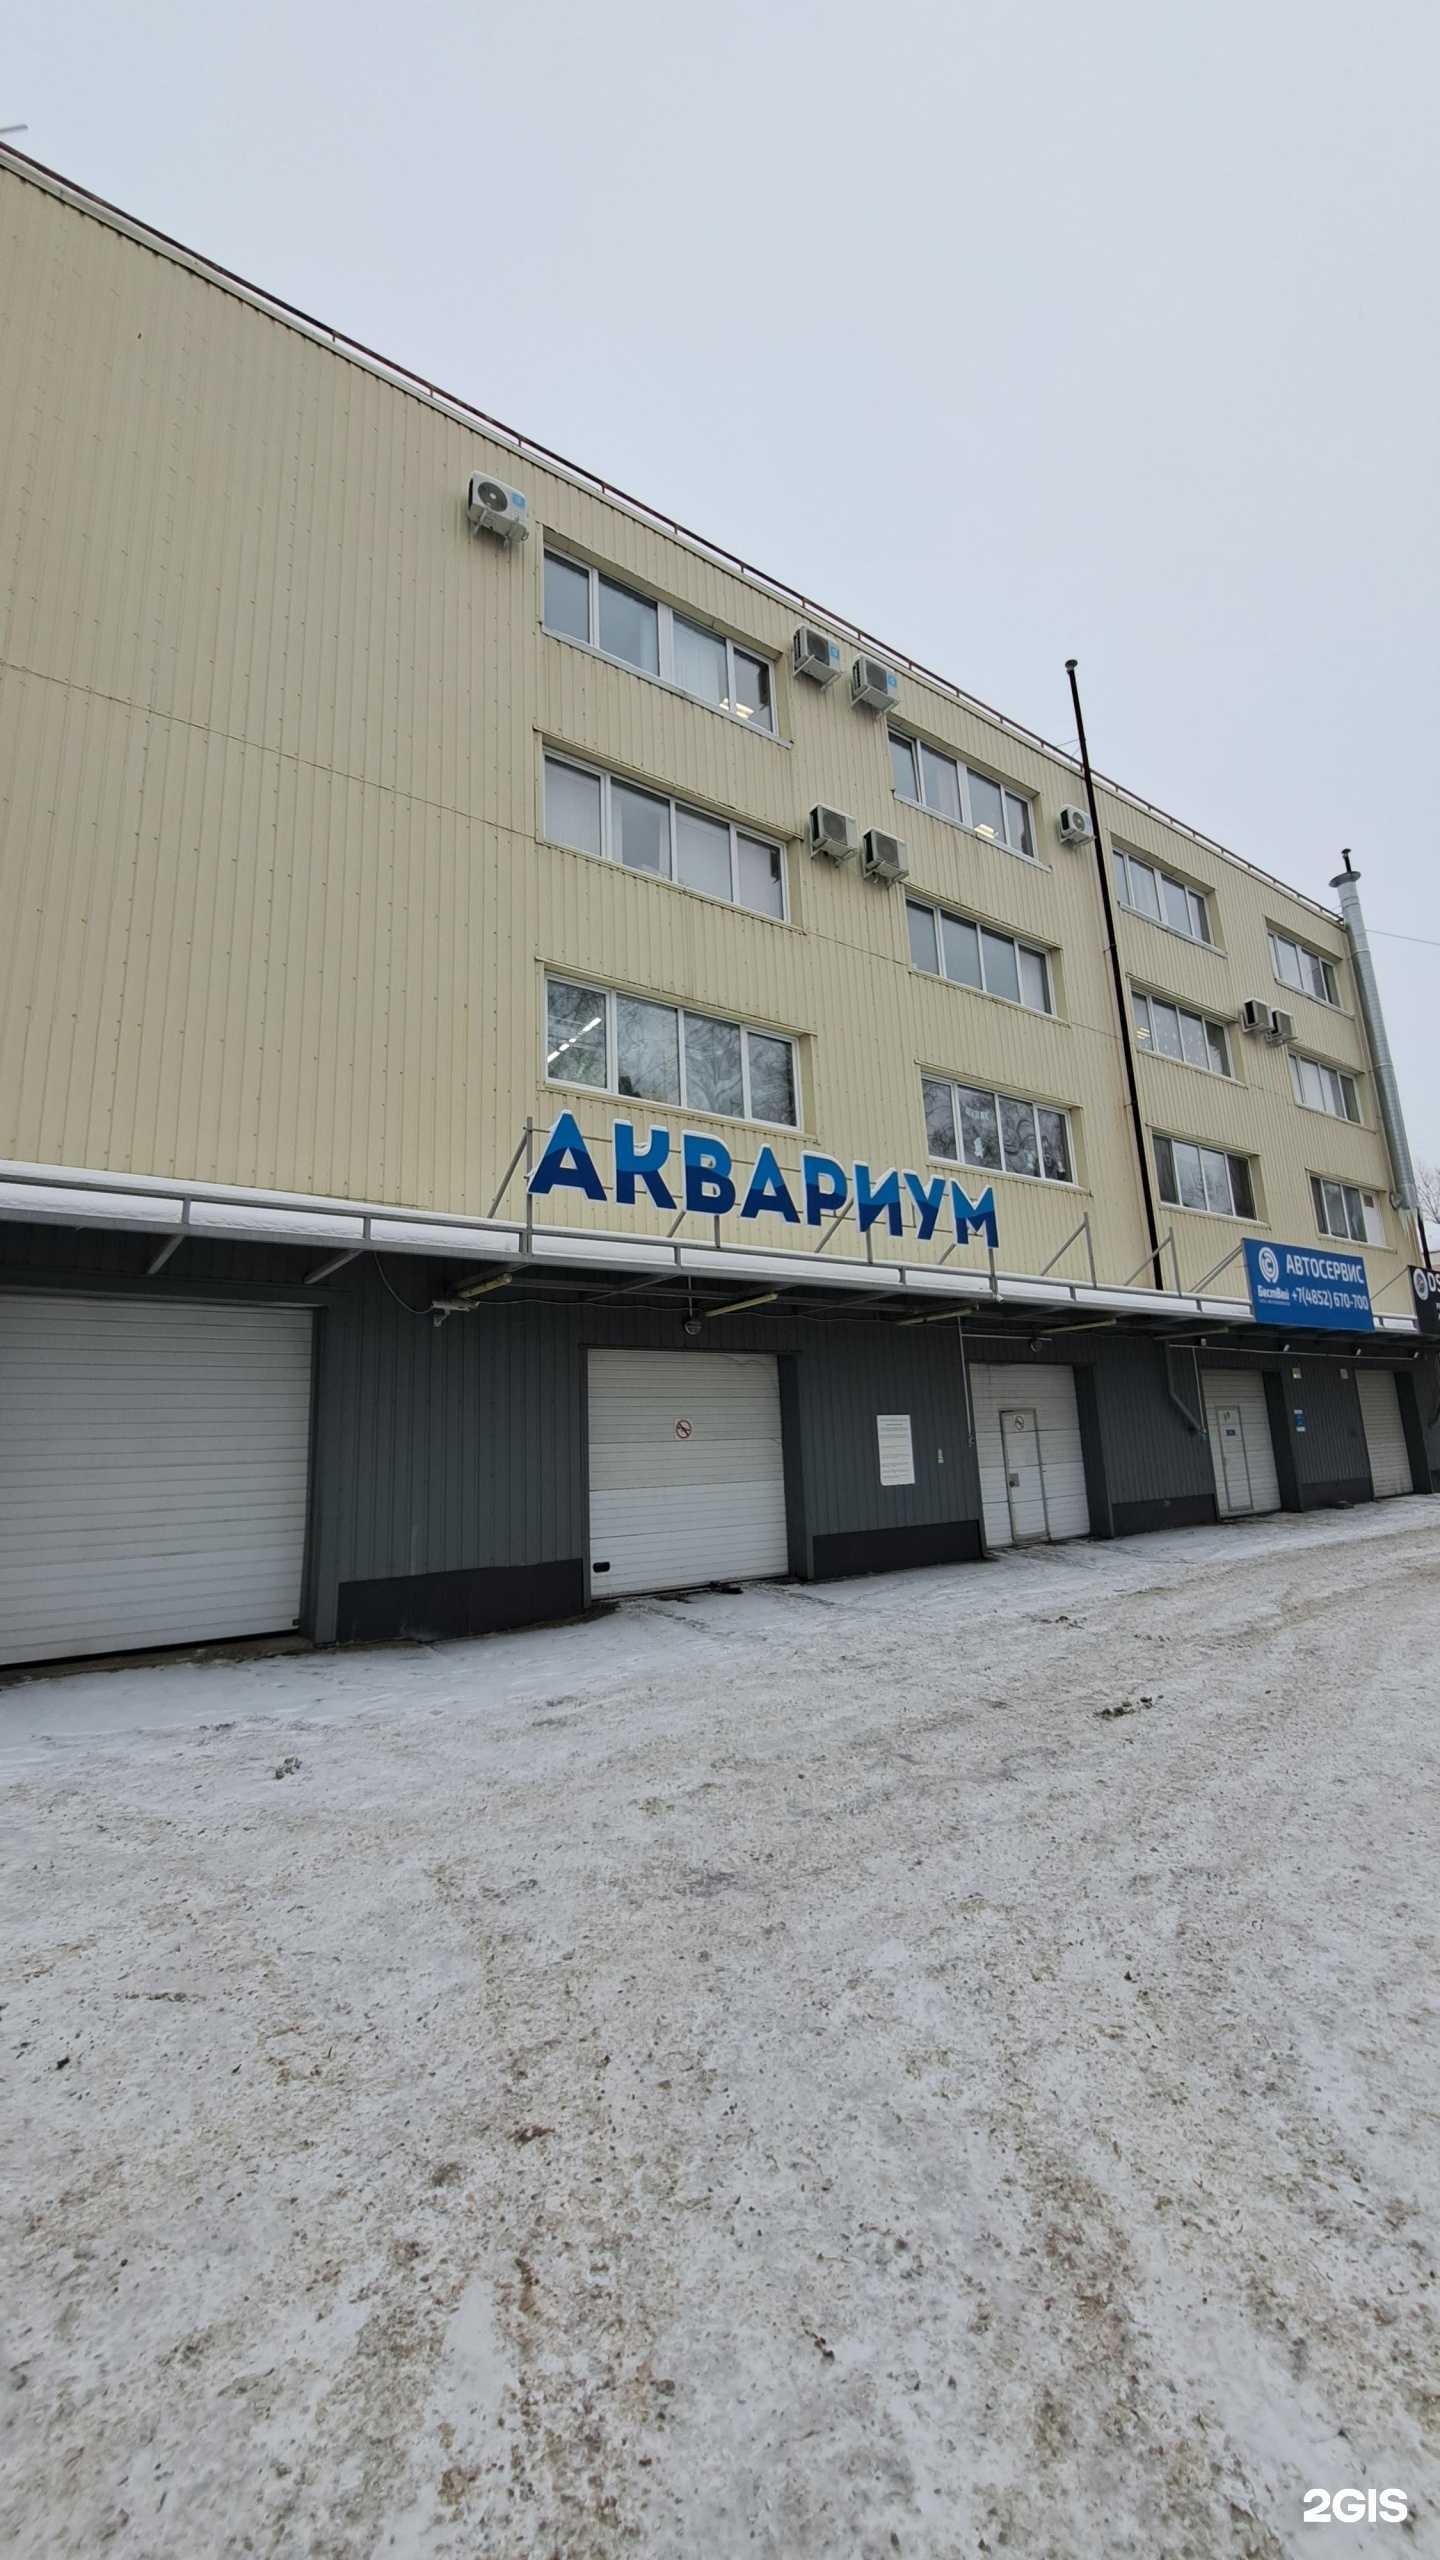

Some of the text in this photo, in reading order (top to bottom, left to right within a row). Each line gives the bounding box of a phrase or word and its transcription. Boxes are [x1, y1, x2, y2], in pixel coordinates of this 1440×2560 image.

[528, 1110, 999, 1247] АКВАРИУМ
[1286, 1254, 1365, 1284] АВТОСЕРВИС
[1332, 1292, 1369, 1310] 670-700
